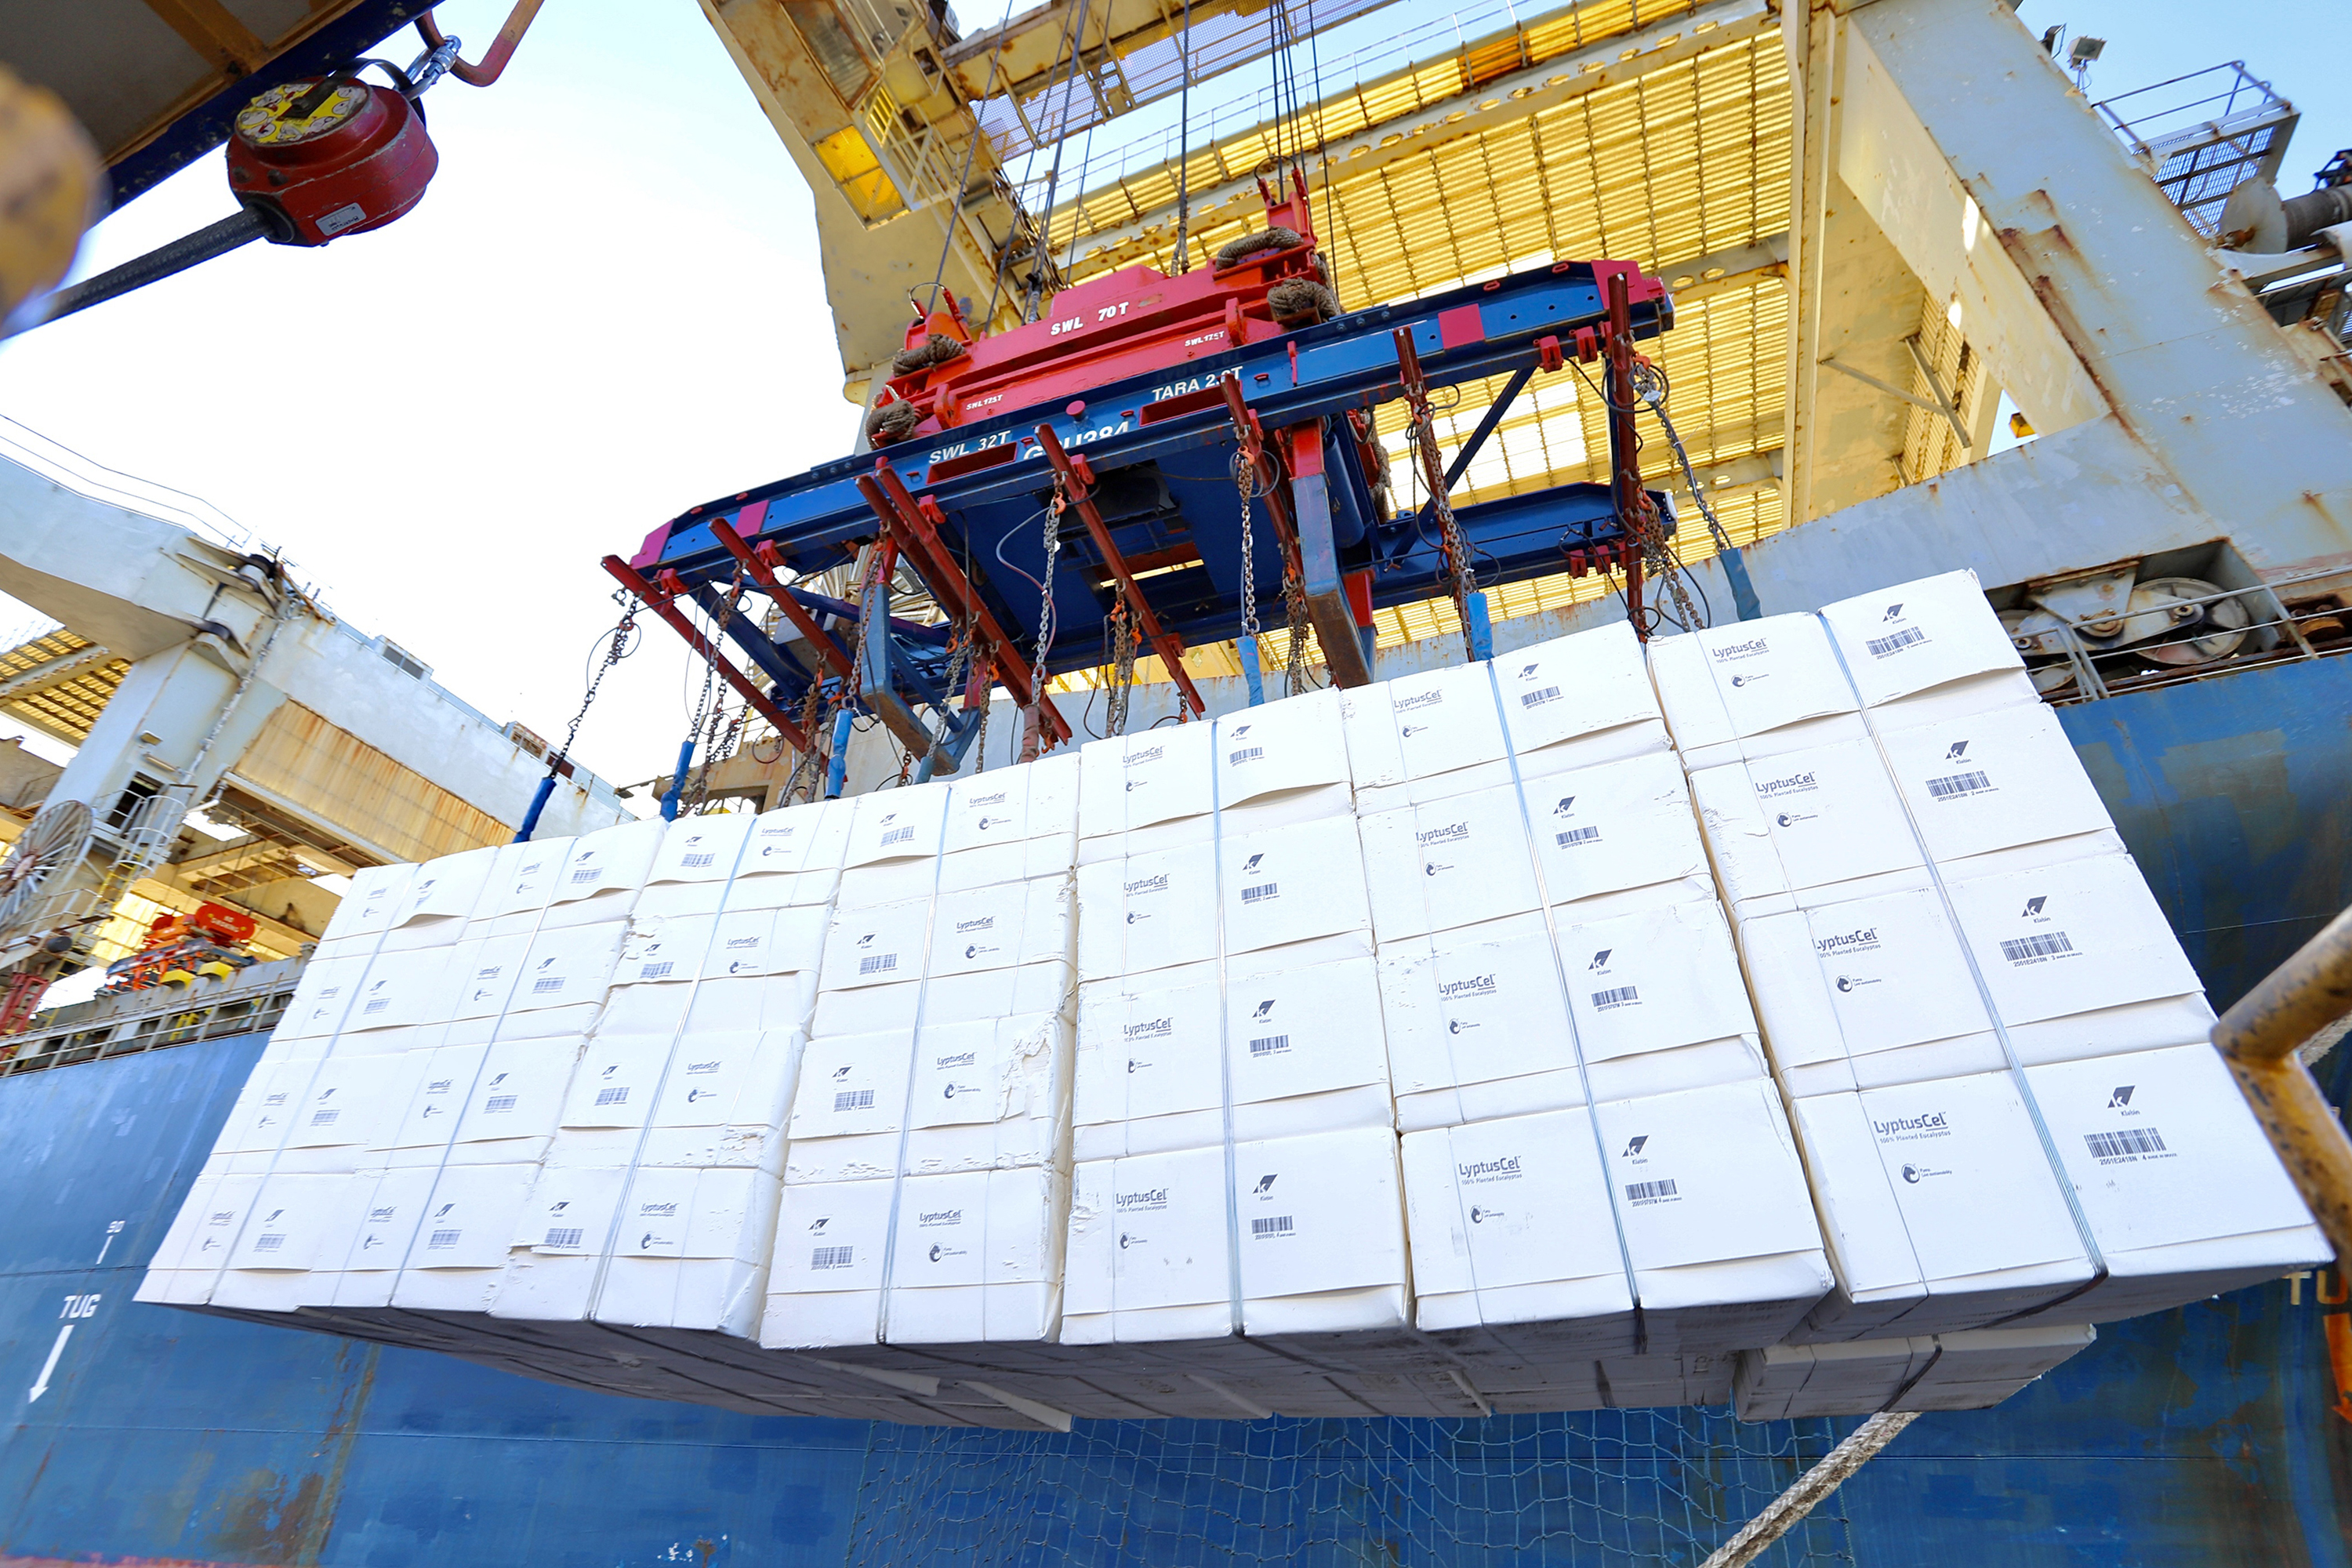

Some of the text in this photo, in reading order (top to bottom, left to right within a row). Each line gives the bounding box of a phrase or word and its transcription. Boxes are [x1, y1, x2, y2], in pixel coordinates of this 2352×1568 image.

[1051, 317, 1083, 336] SWL
[1152, 378, 1200, 401] TARA
[928, 430, 1011, 464] SWL 32T
[1712, 638, 1766, 659] LyptusCel
[1393, 689, 1441, 710] LyptusCel
[1122, 746, 1163, 764] LyptusCel
[1755, 771, 1816, 794] LyptusCel
[1439, 975, 1494, 995] LyptusCel
[1123, 1018, 1171, 1037] LyptusCel
[1874, 1112, 1947, 1135] LyptusCel
[1458, 1156, 1520, 1177] LyptusCel
[1116, 1189, 1167, 1207] LyptusCel
[59, 1294, 101, 1319] TUG
